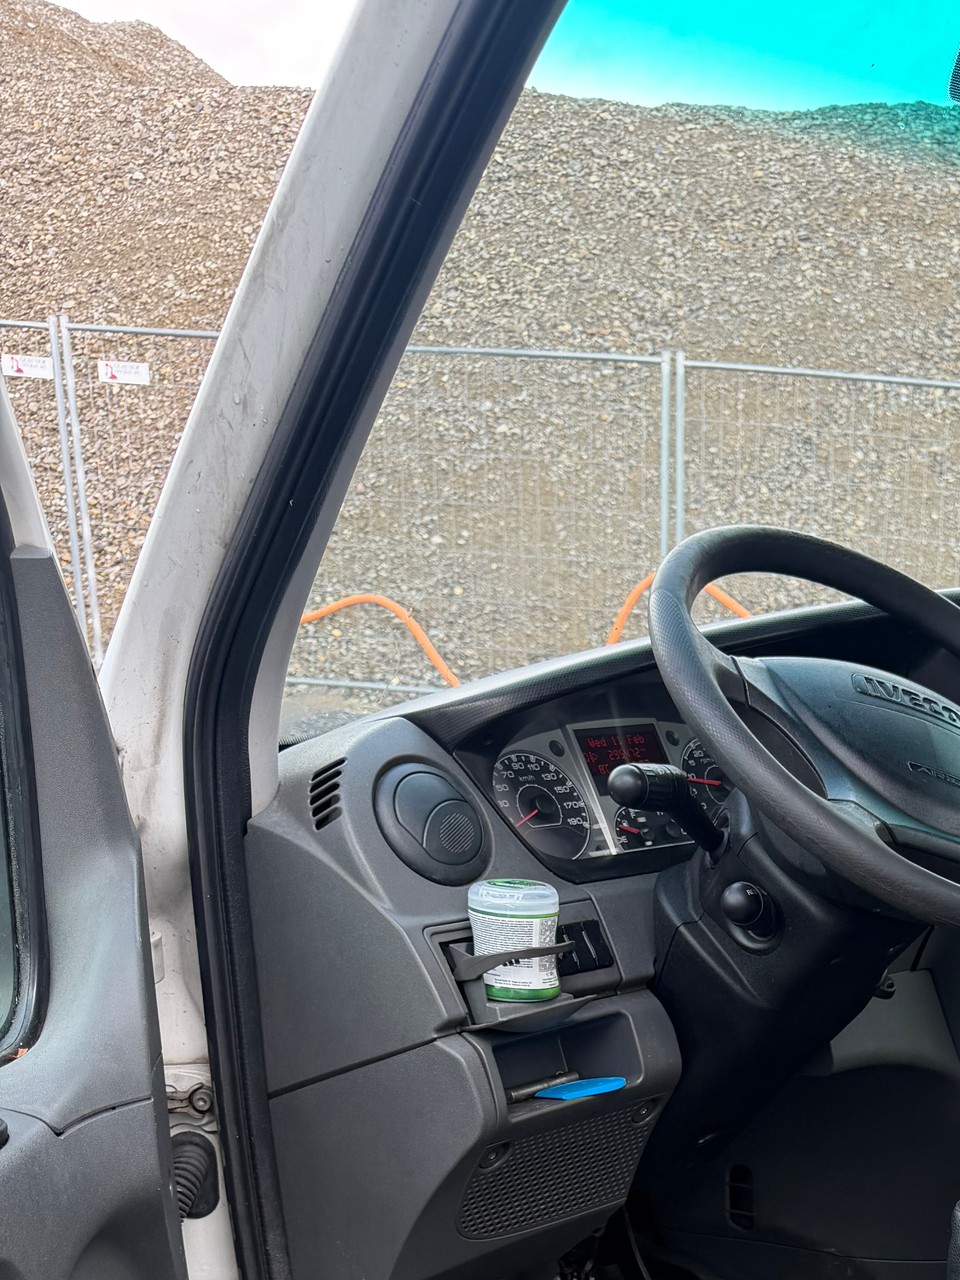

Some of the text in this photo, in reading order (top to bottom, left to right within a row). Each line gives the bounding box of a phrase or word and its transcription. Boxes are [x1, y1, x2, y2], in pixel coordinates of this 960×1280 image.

[511, 762, 525, 770] 90
[527, 763, 541, 771] 110
[501, 771, 515, 779] 70
[541, 772, 558, 781] 130
[554, 786, 570, 794] 150
[563, 801, 580, 810] 170
